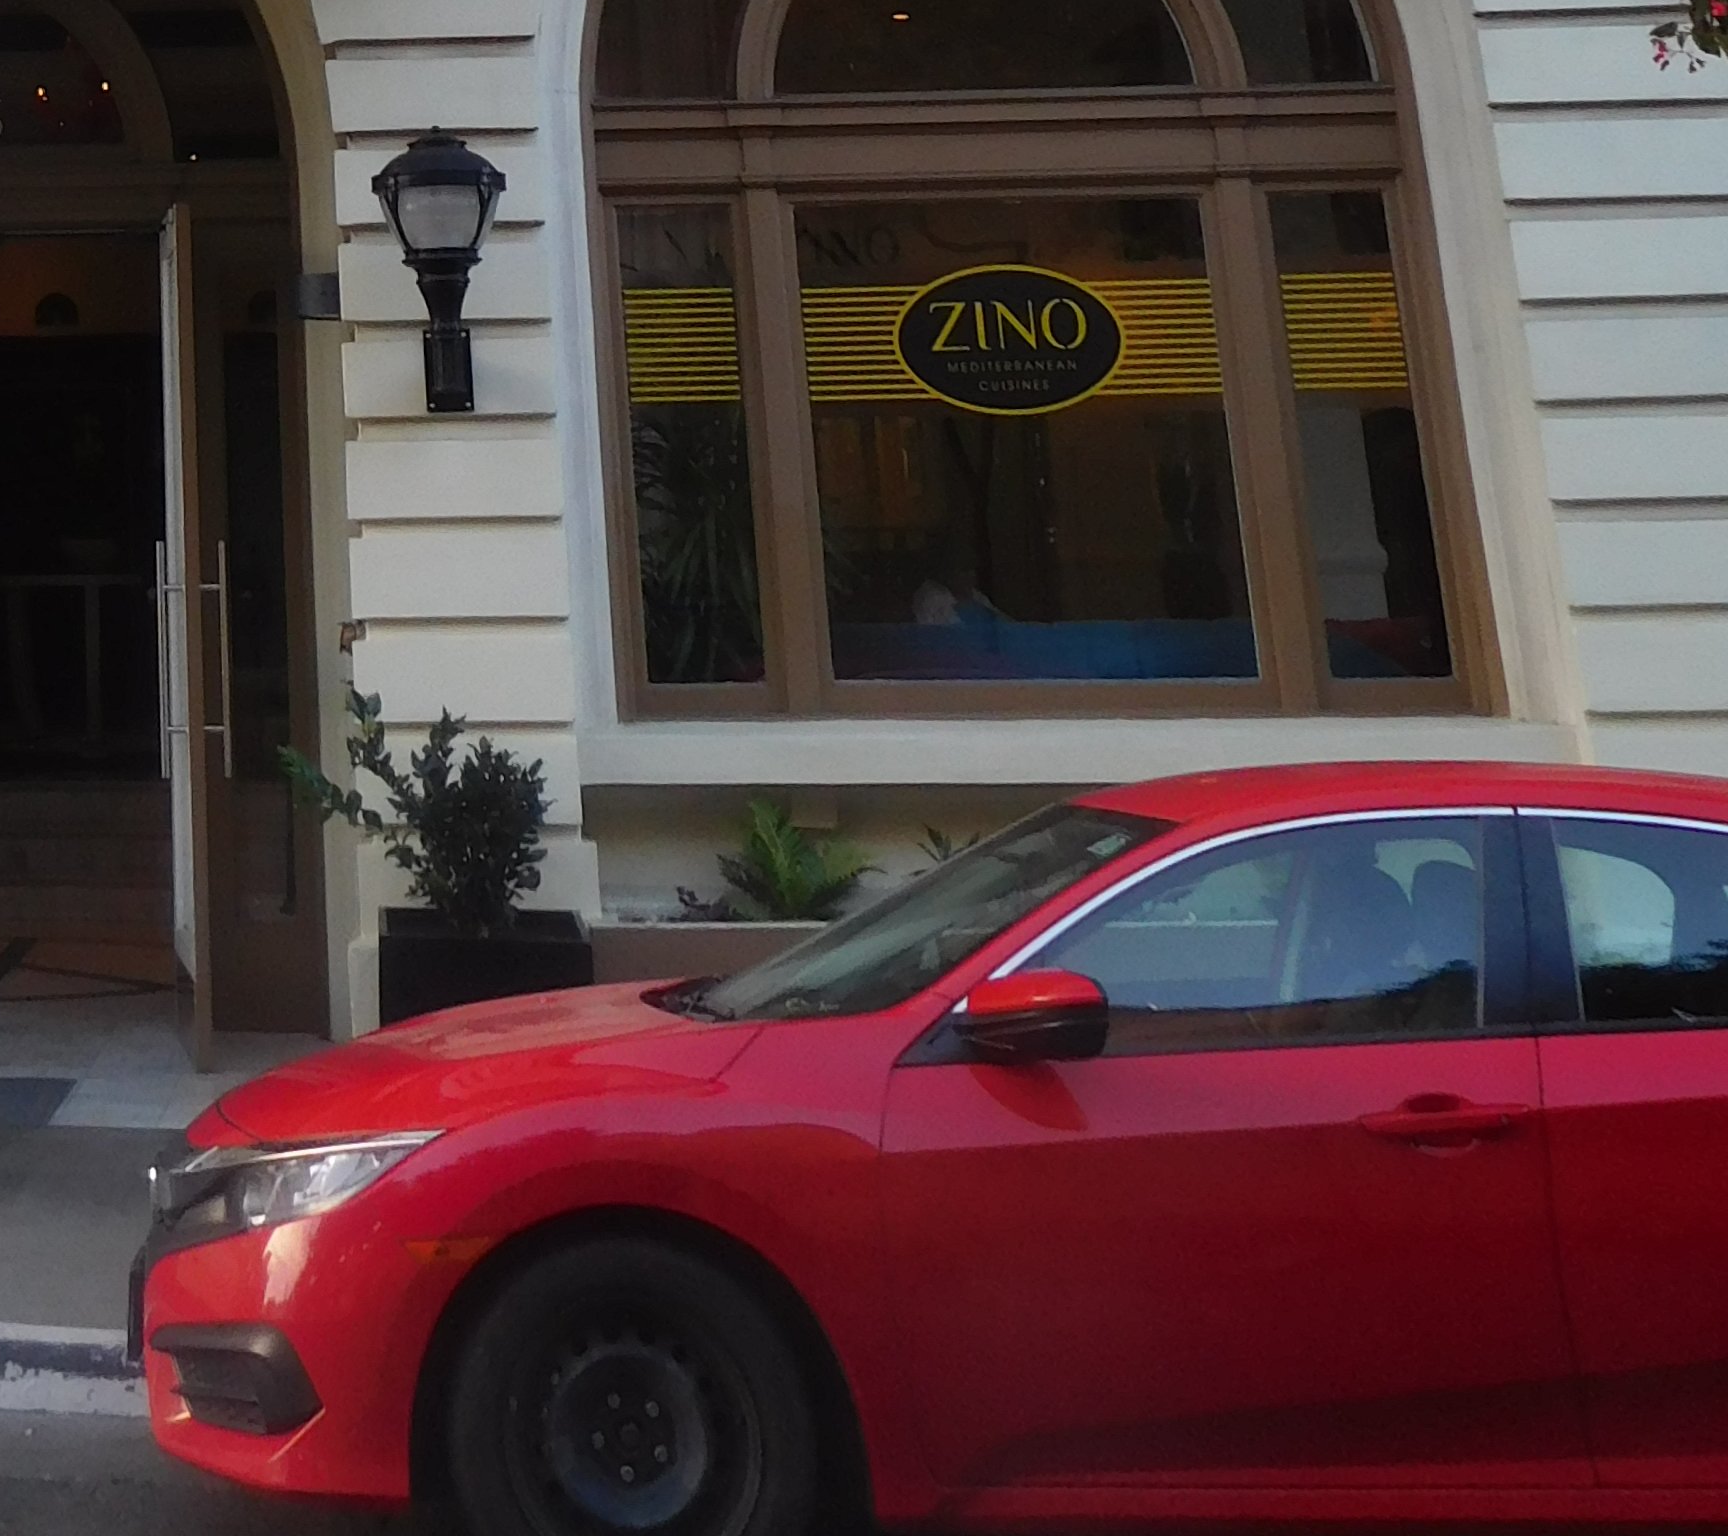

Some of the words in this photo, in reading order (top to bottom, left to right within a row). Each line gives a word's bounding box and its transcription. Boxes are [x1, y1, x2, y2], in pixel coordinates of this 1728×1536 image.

[928, 298, 1087, 352] ZINO
[946, 358, 1078, 374] MEDITERRANEAN
[978, 378, 1051, 392] CUISINES
